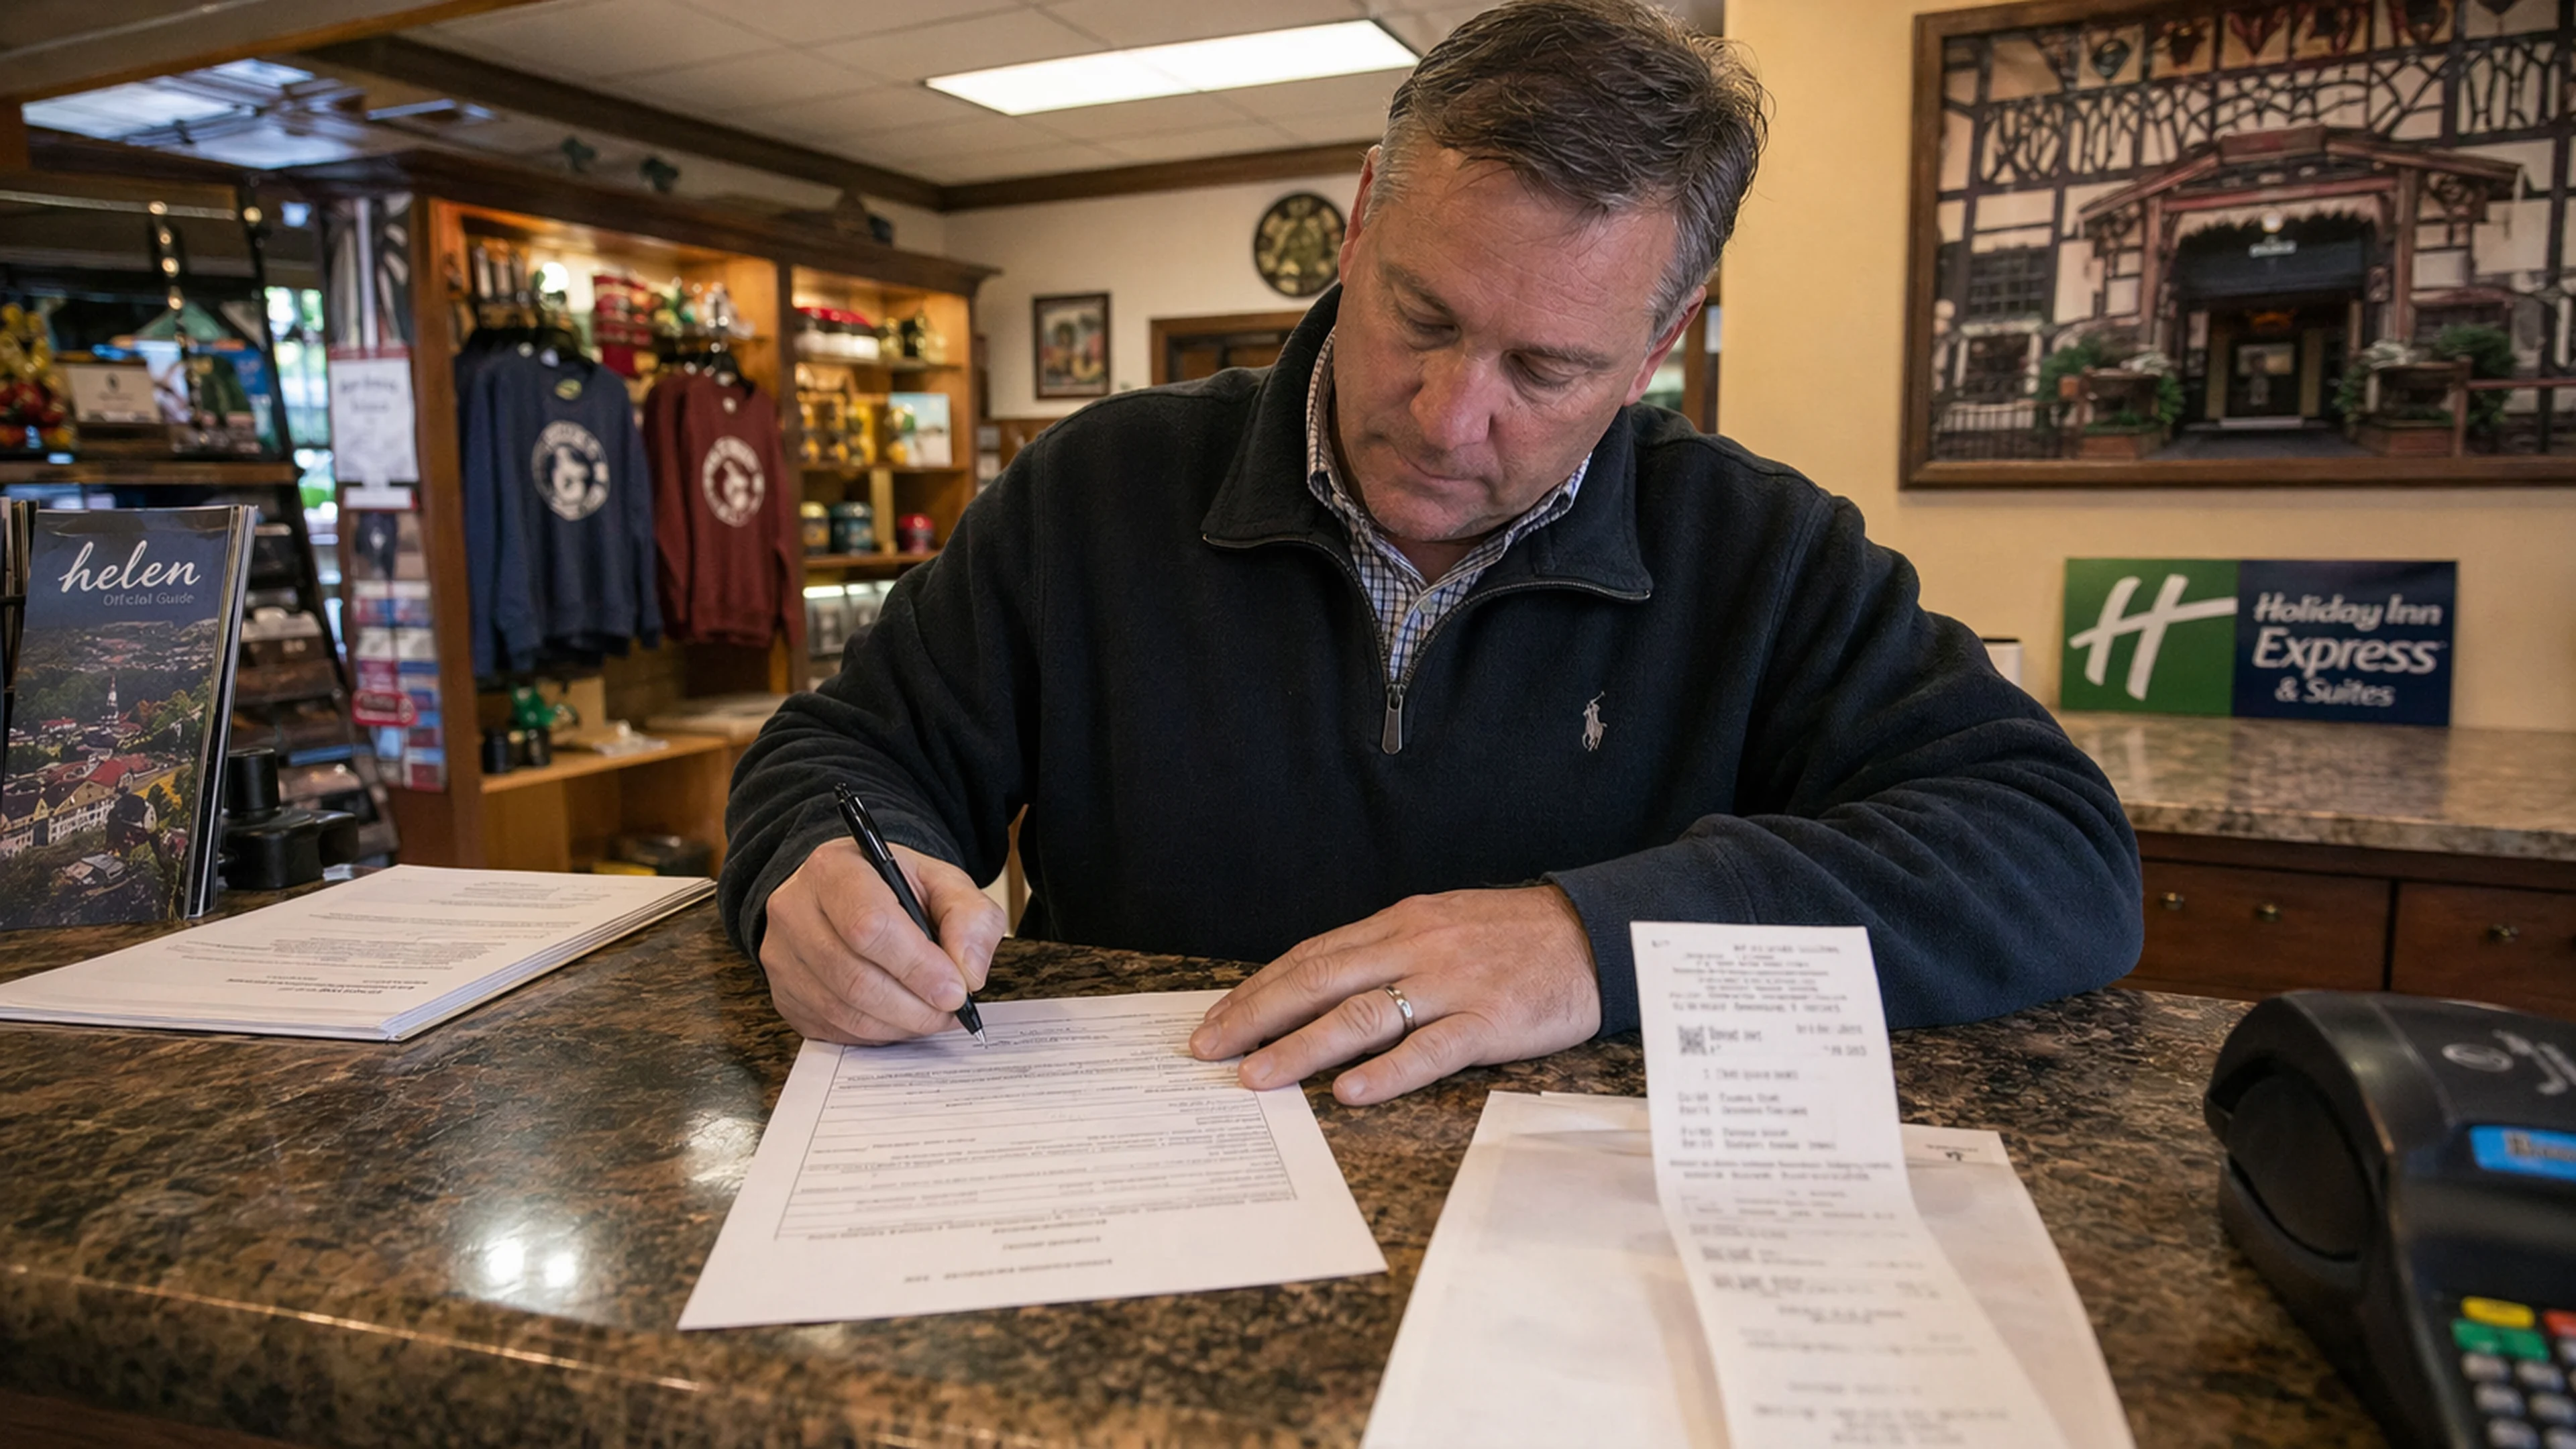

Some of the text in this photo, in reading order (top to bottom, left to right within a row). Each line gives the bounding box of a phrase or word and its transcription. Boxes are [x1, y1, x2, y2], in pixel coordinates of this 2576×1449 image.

[58, 539, 201, 593] helen
[156, 592, 195, 605] Guide
[2253, 592, 2443, 632] Holiday Inn
[2252, 626, 2440, 680] Express
[2275, 676, 2396, 707] & Suites
